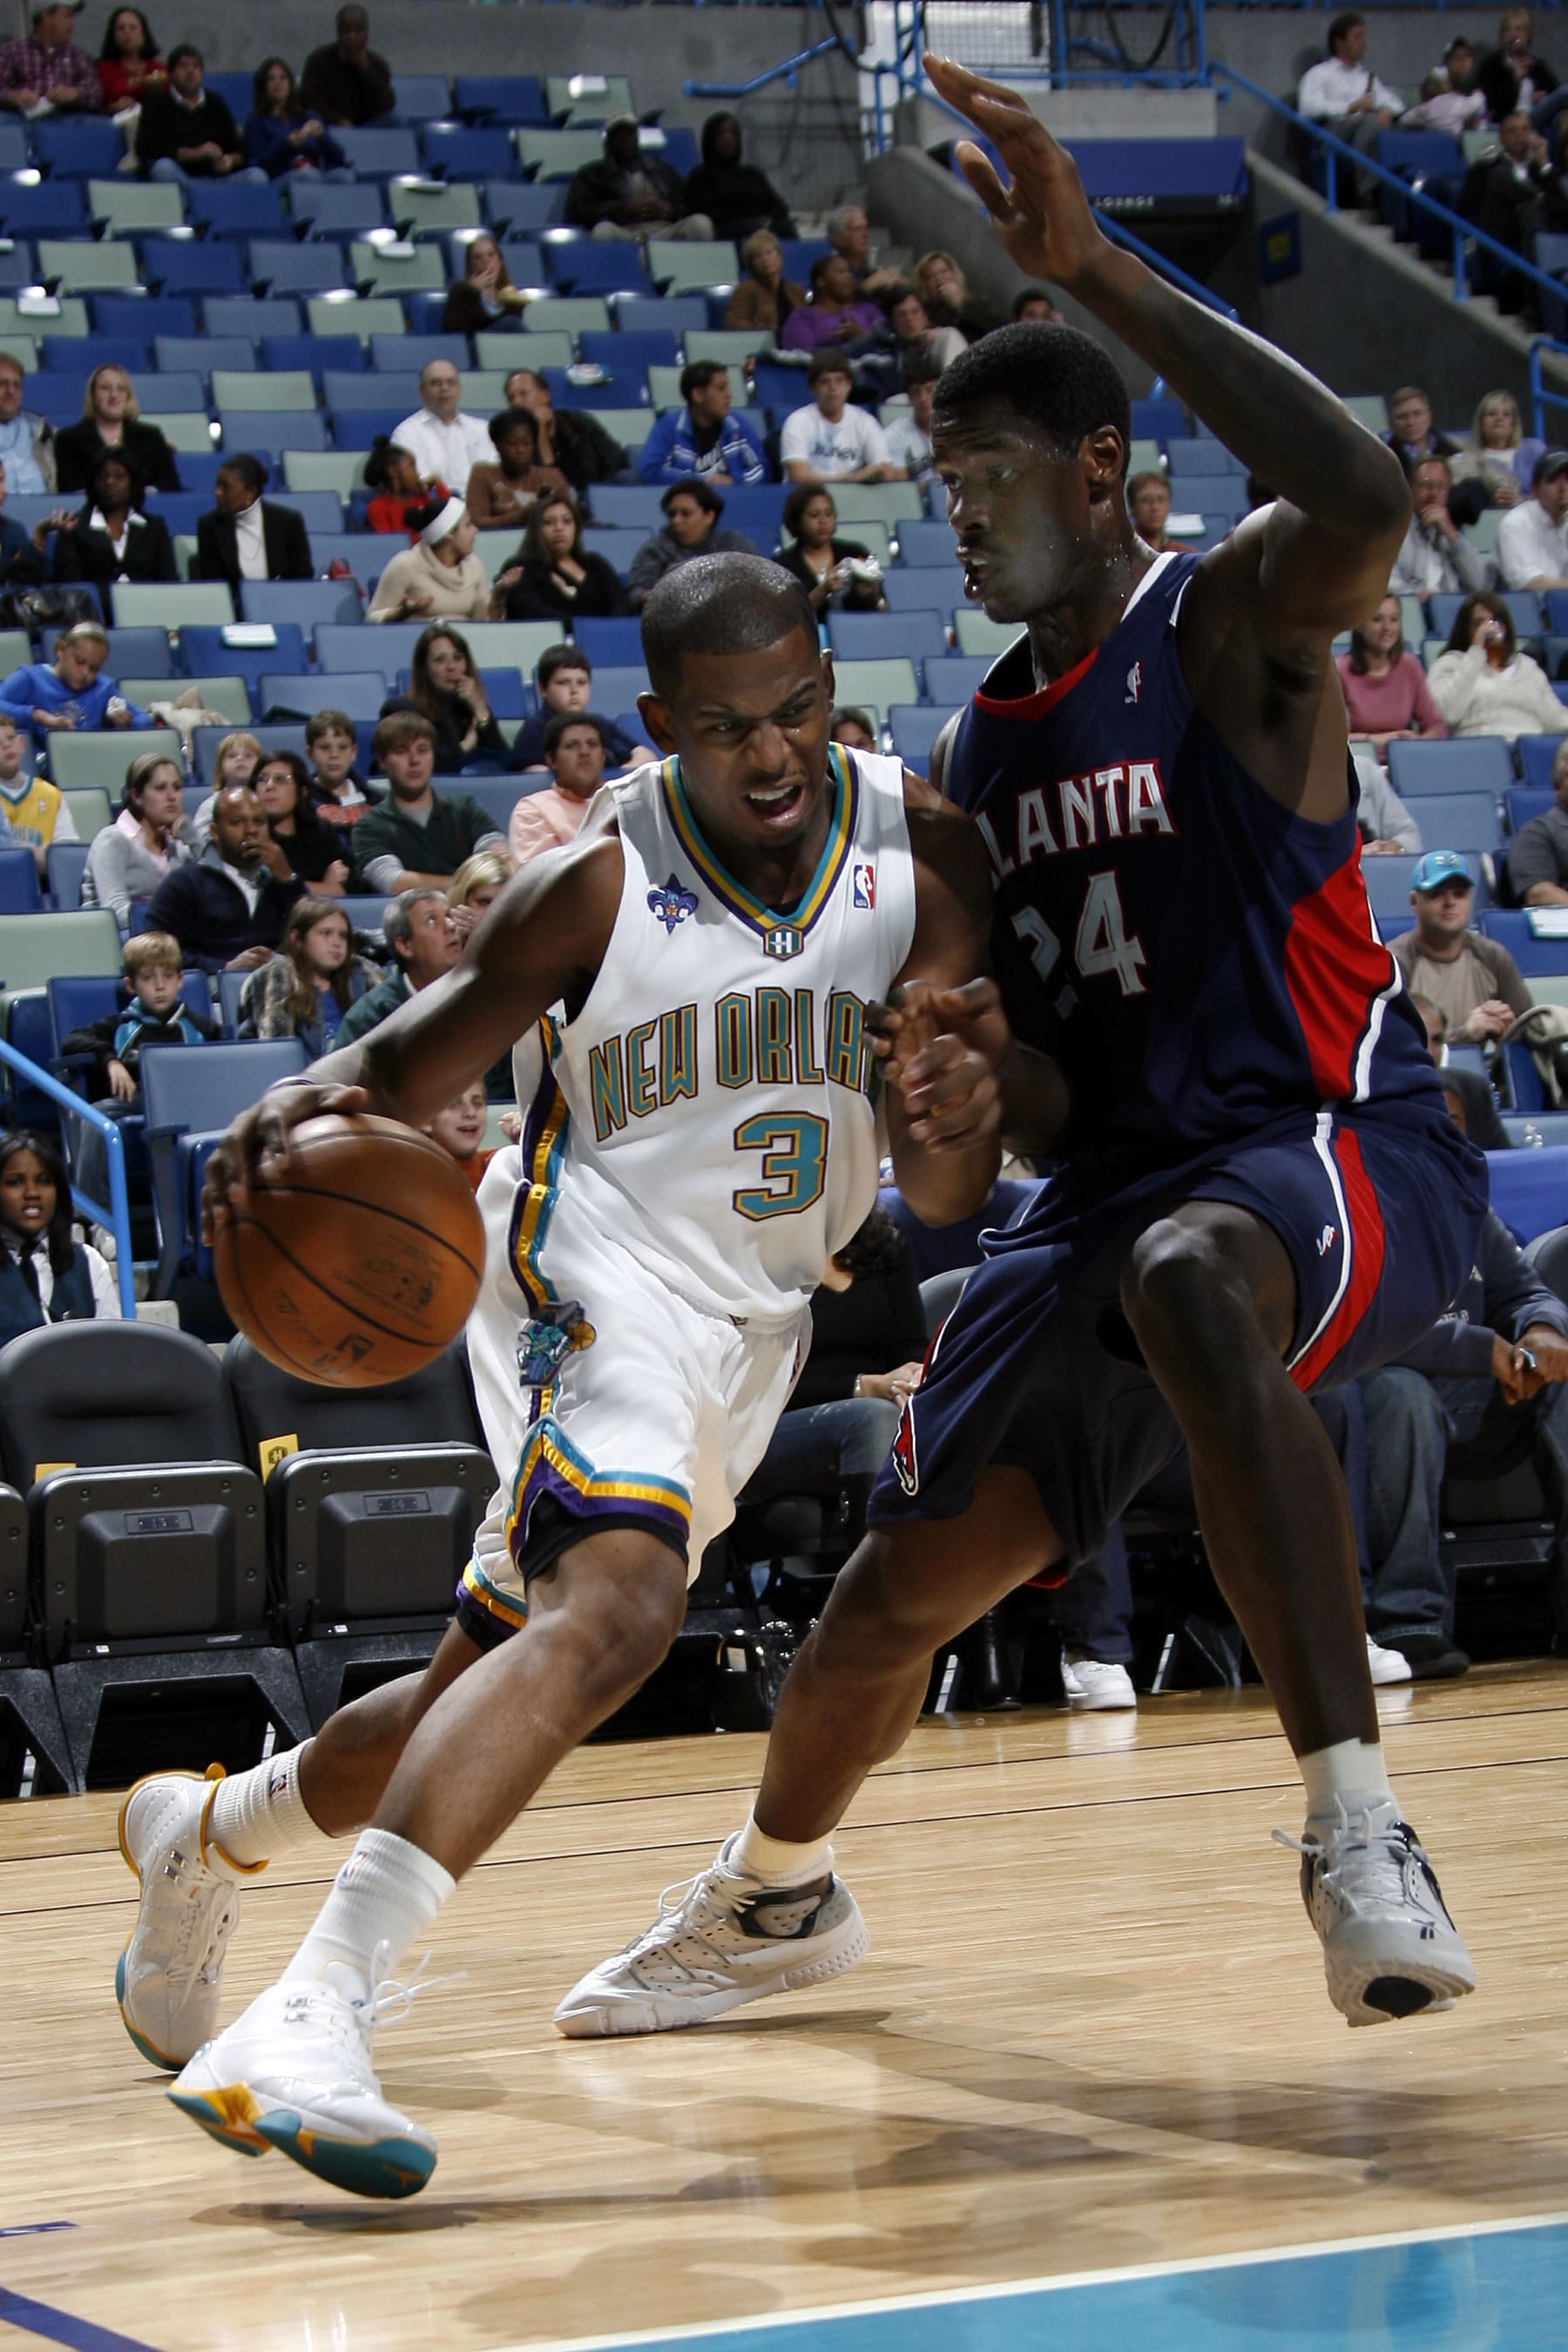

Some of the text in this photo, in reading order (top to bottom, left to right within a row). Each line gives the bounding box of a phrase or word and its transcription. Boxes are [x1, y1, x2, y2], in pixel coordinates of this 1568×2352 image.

[1095, 195, 1155, 207] LOUNGE
[973, 760, 1179, 882] LANTA
[589, 986, 872, 1143] NEW ORLA
[733, 1111, 829, 1221] 3
